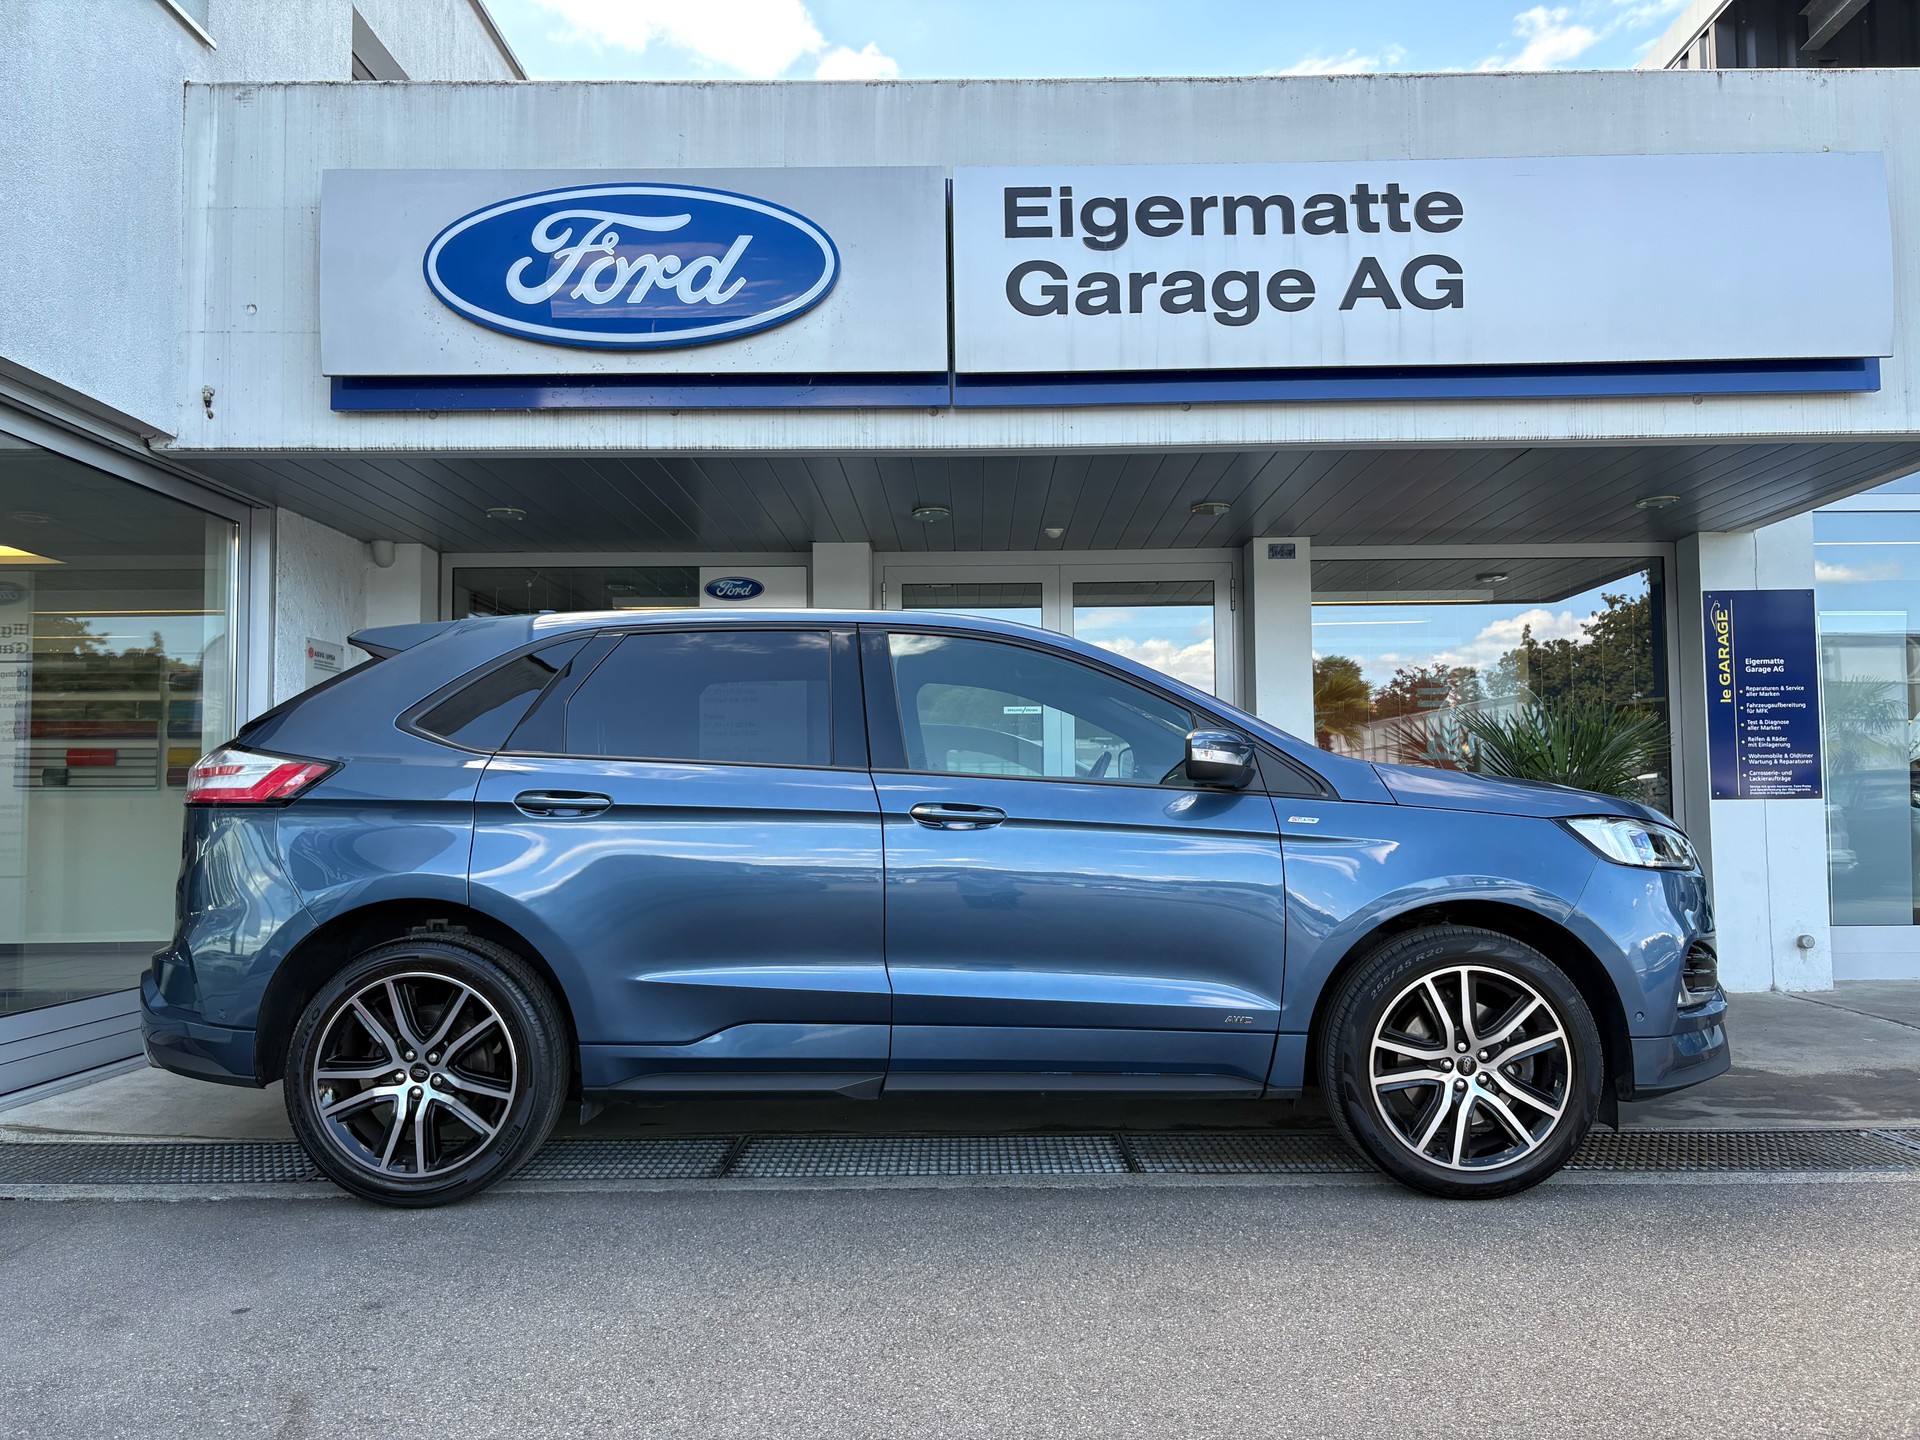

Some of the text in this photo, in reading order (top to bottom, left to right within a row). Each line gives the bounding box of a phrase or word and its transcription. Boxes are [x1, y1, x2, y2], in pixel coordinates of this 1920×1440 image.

[1004, 183, 1464, 251] Eigermatte
[506, 209, 753, 305] Ford
[1005, 254, 1464, 327] Garage AG
[716, 580, 752, 596] Ford
[1716, 610, 1731, 702] le GARAGE
[1371, 947, 1443, 1000] 255/45 R20
